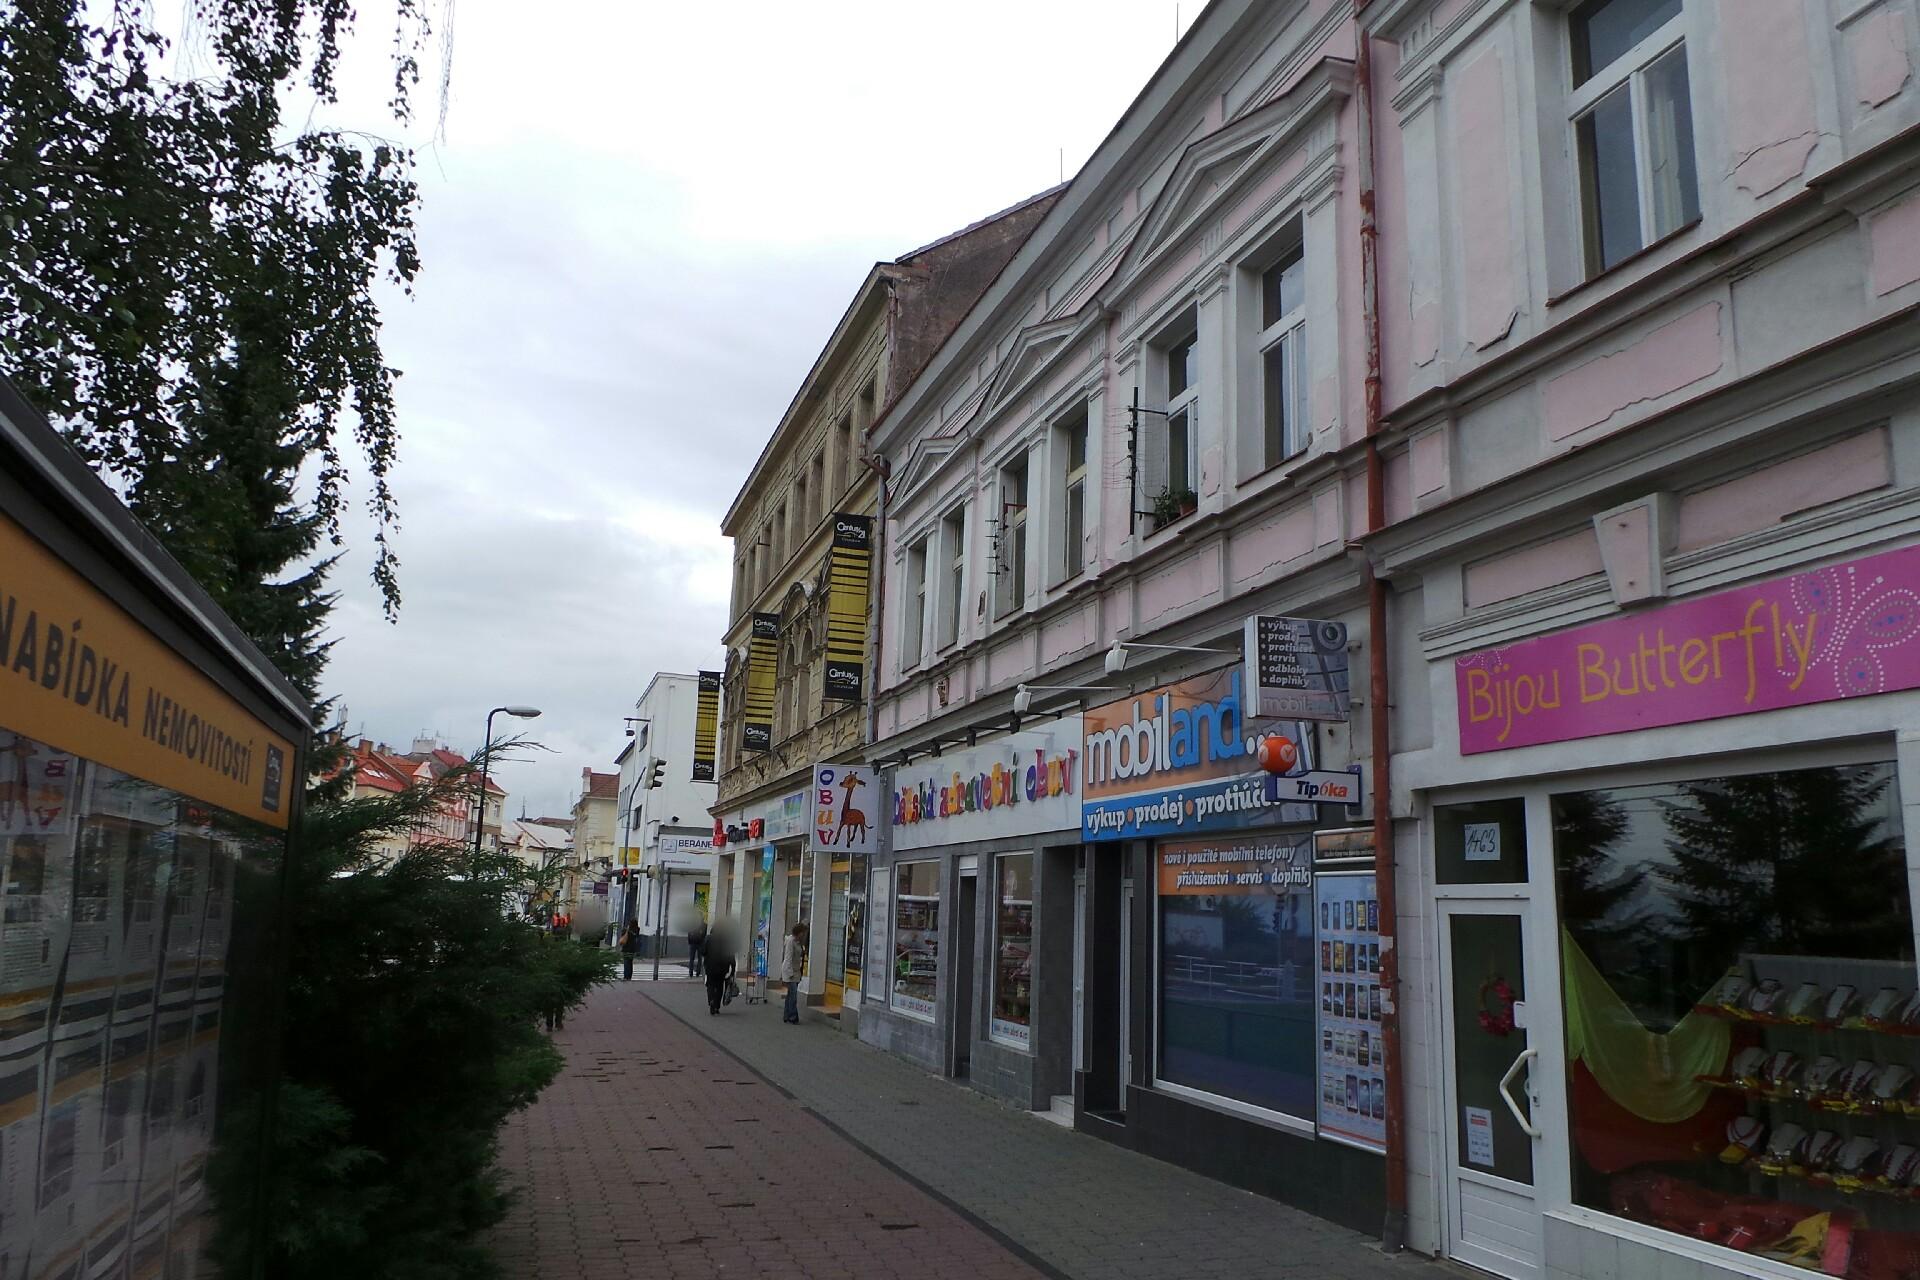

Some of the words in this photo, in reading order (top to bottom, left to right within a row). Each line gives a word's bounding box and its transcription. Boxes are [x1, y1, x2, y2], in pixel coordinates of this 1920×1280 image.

[1267, 620, 1297, 634] výkup
[1268, 653, 1296, 663] servis
[1268, 663, 1308, 677] odbloky
[1467, 663, 1561, 743] Bijou
[1577, 598, 1817, 705] Butterfly
[1269, 675, 1309, 687] doplňky
[143, 687, 253, 786] NEMOVITOSTÍ
[1025, 748, 1077, 802] obuv
[1086, 806, 1125, 834] výkup
[1135, 793, 1184, 829] prodej
[1195, 780, 1281, 823] protiúč
[1163, 852, 1182, 865] nové
[1187, 847, 1218, 867] použité
[1219, 845, 1254, 863] mobilní
[1255, 843, 1296, 864] telefony
[1176, 869, 1230, 888] příslušenství
[1236, 869, 1263, 884] servis
